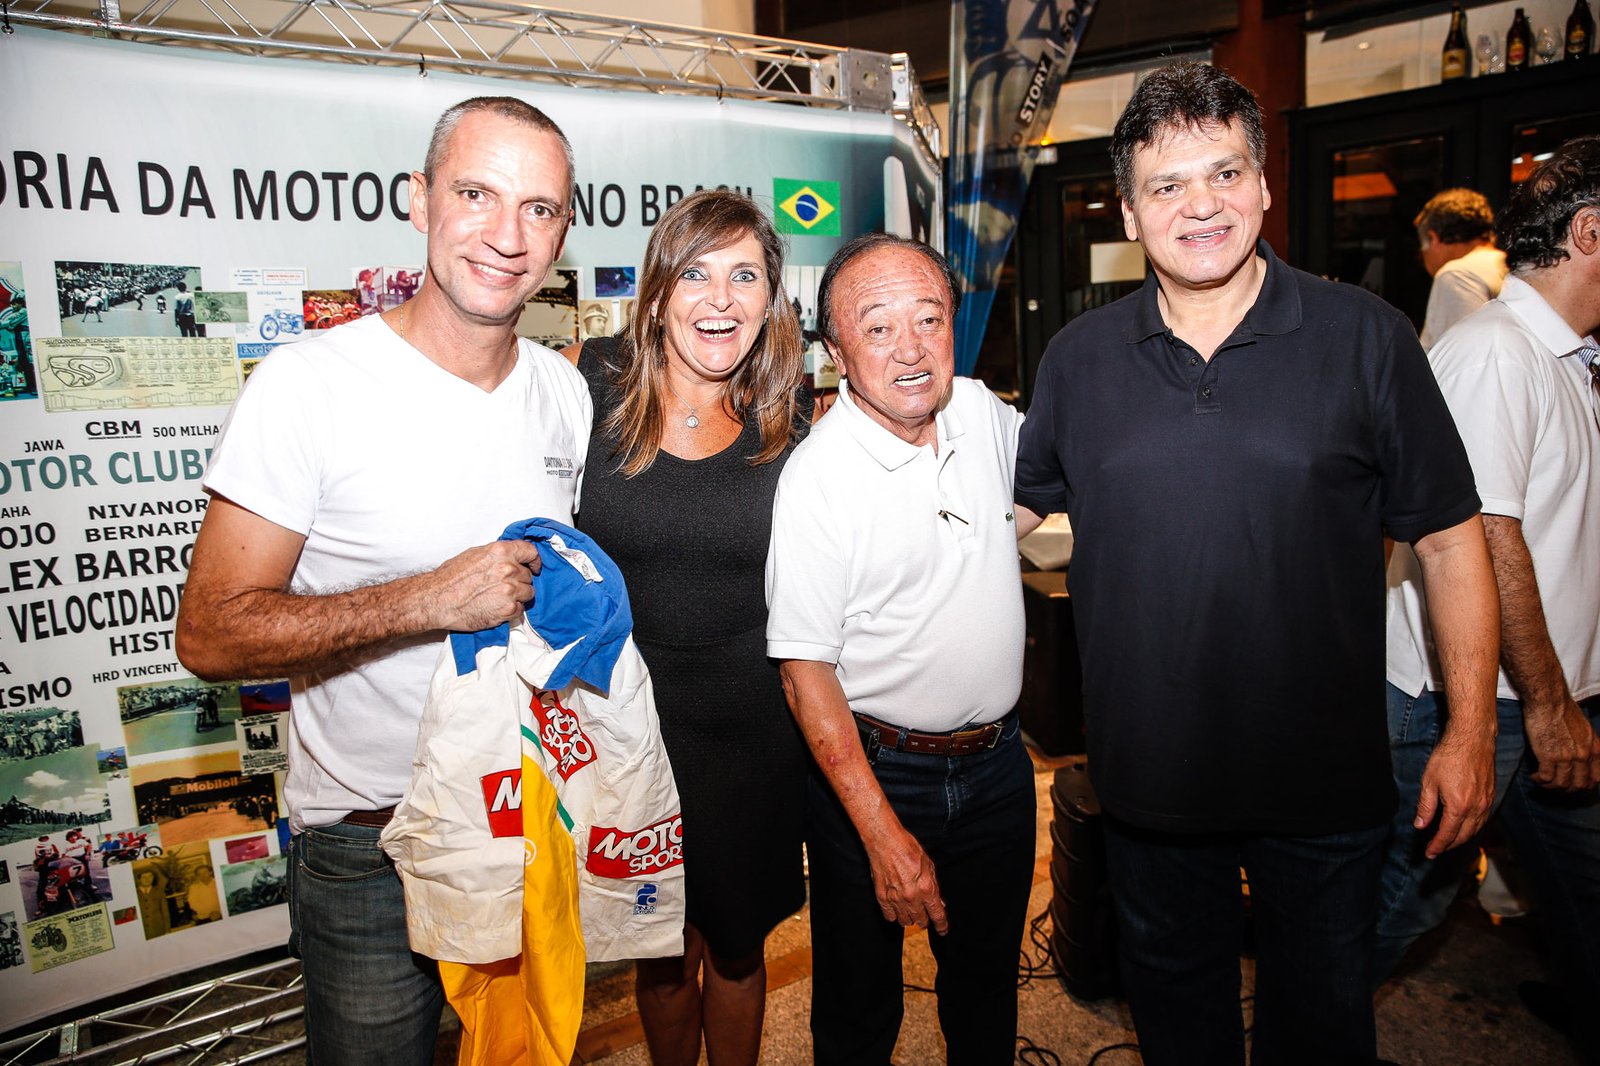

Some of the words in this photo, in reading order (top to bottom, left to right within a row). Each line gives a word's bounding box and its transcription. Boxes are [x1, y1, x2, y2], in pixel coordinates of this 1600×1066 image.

[1020, 60, 1049, 123] STORY
[0, 151, 119, 213] RIA
[138, 161, 216, 219] DA
[572, 183, 626, 228] NO
[85, 420, 142, 435] CBM
[152, 426, 176, 438] 500
[180, 424, 222, 437] MILHA
[24, 439, 65, 453] JAWA
[88, 498, 208, 520] NIVANOR
[0, 556, 63, 594] EX
[109, 630, 174, 656] HIST
[92, 670, 120, 684] HRD
[123, 662, 179, 678] VINCENT
[186, 776, 238, 793] Mobiloil
[629, 846, 683, 874] SPOR
